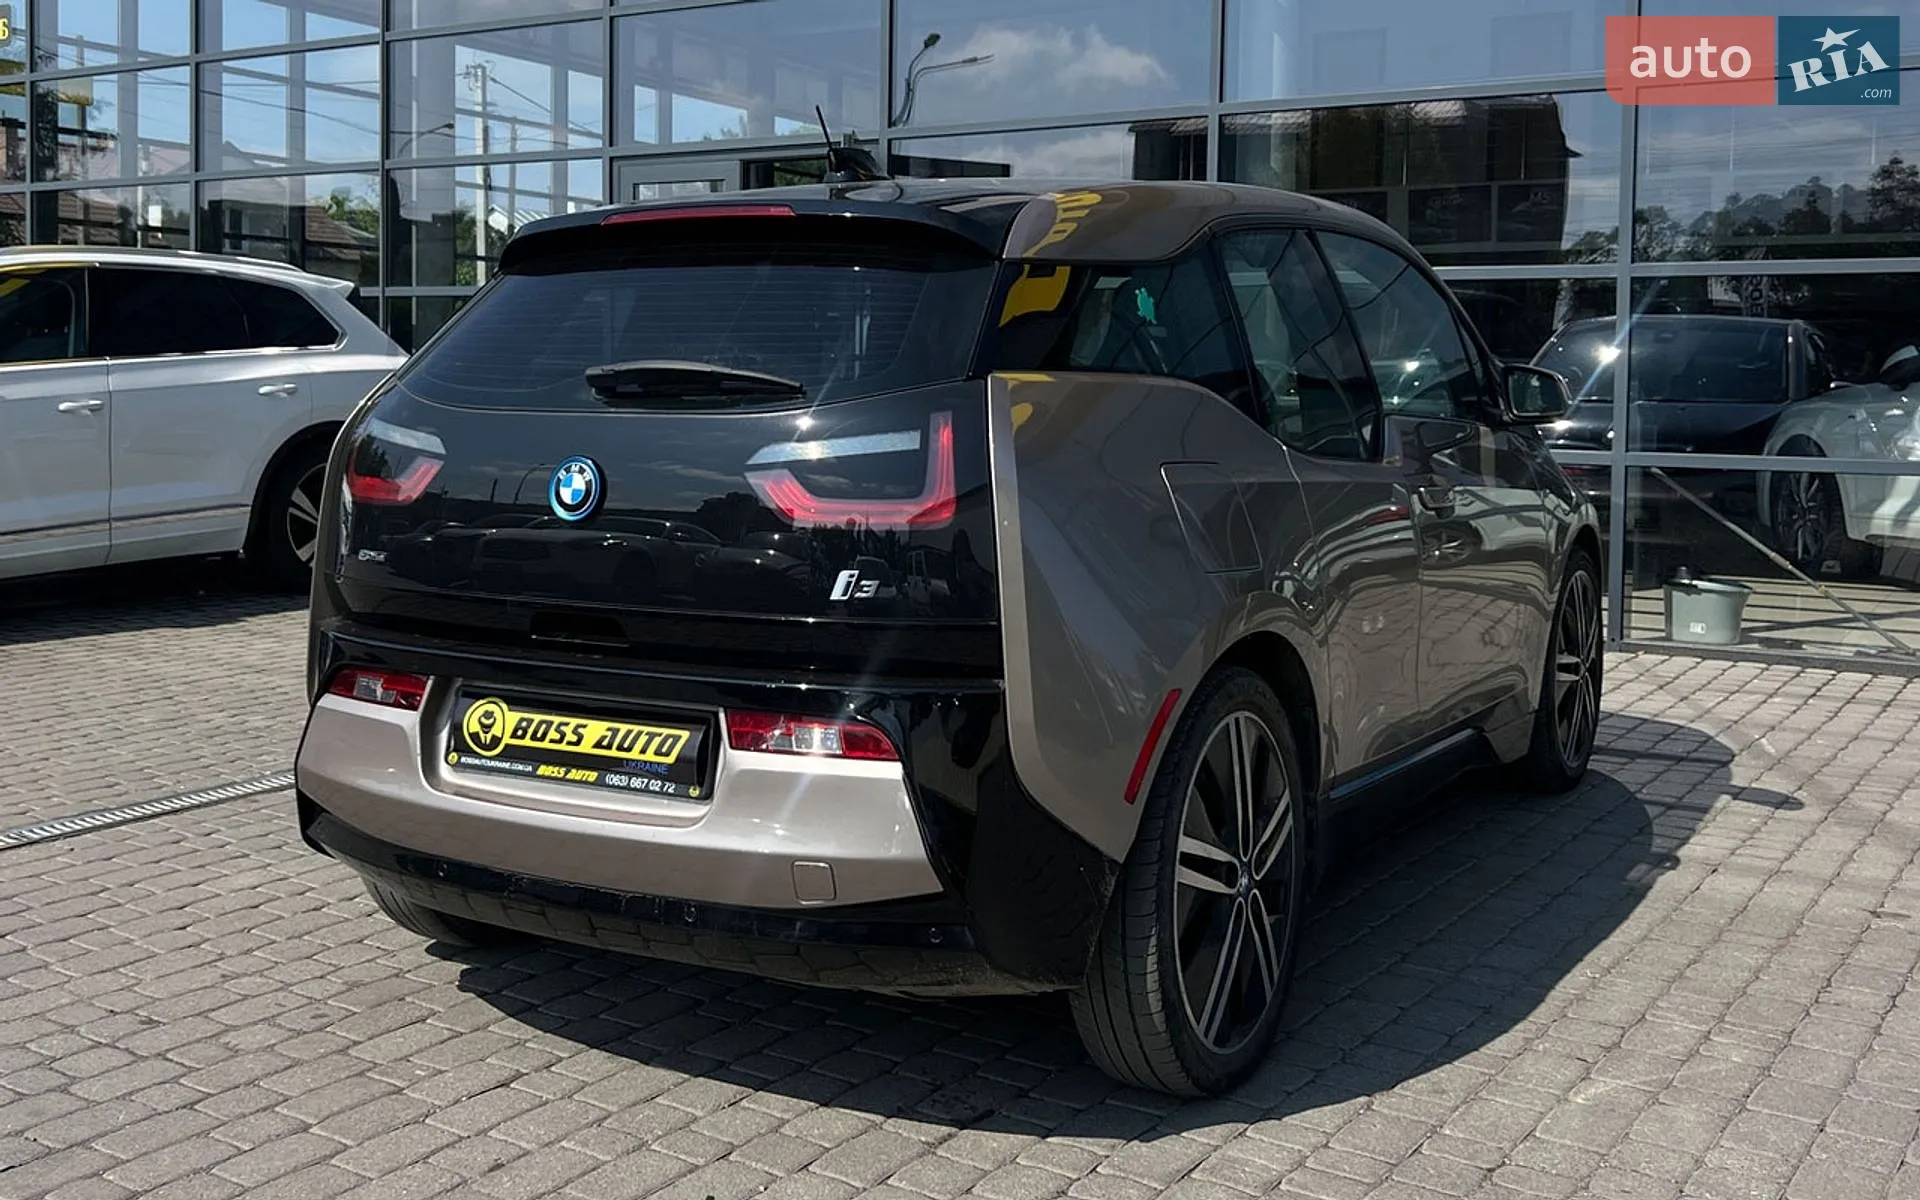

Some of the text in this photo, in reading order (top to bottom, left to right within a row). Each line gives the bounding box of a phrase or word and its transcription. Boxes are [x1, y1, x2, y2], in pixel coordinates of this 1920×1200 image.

[829, 570, 880, 600] i3
[510, 717, 682, 757] BOSS AUTO
[536, 764, 599, 783] BOSS AUTO
[624, 760, 669, 774] UKRAINE
[605, 773, 676, 793] (063) 667 02 72
